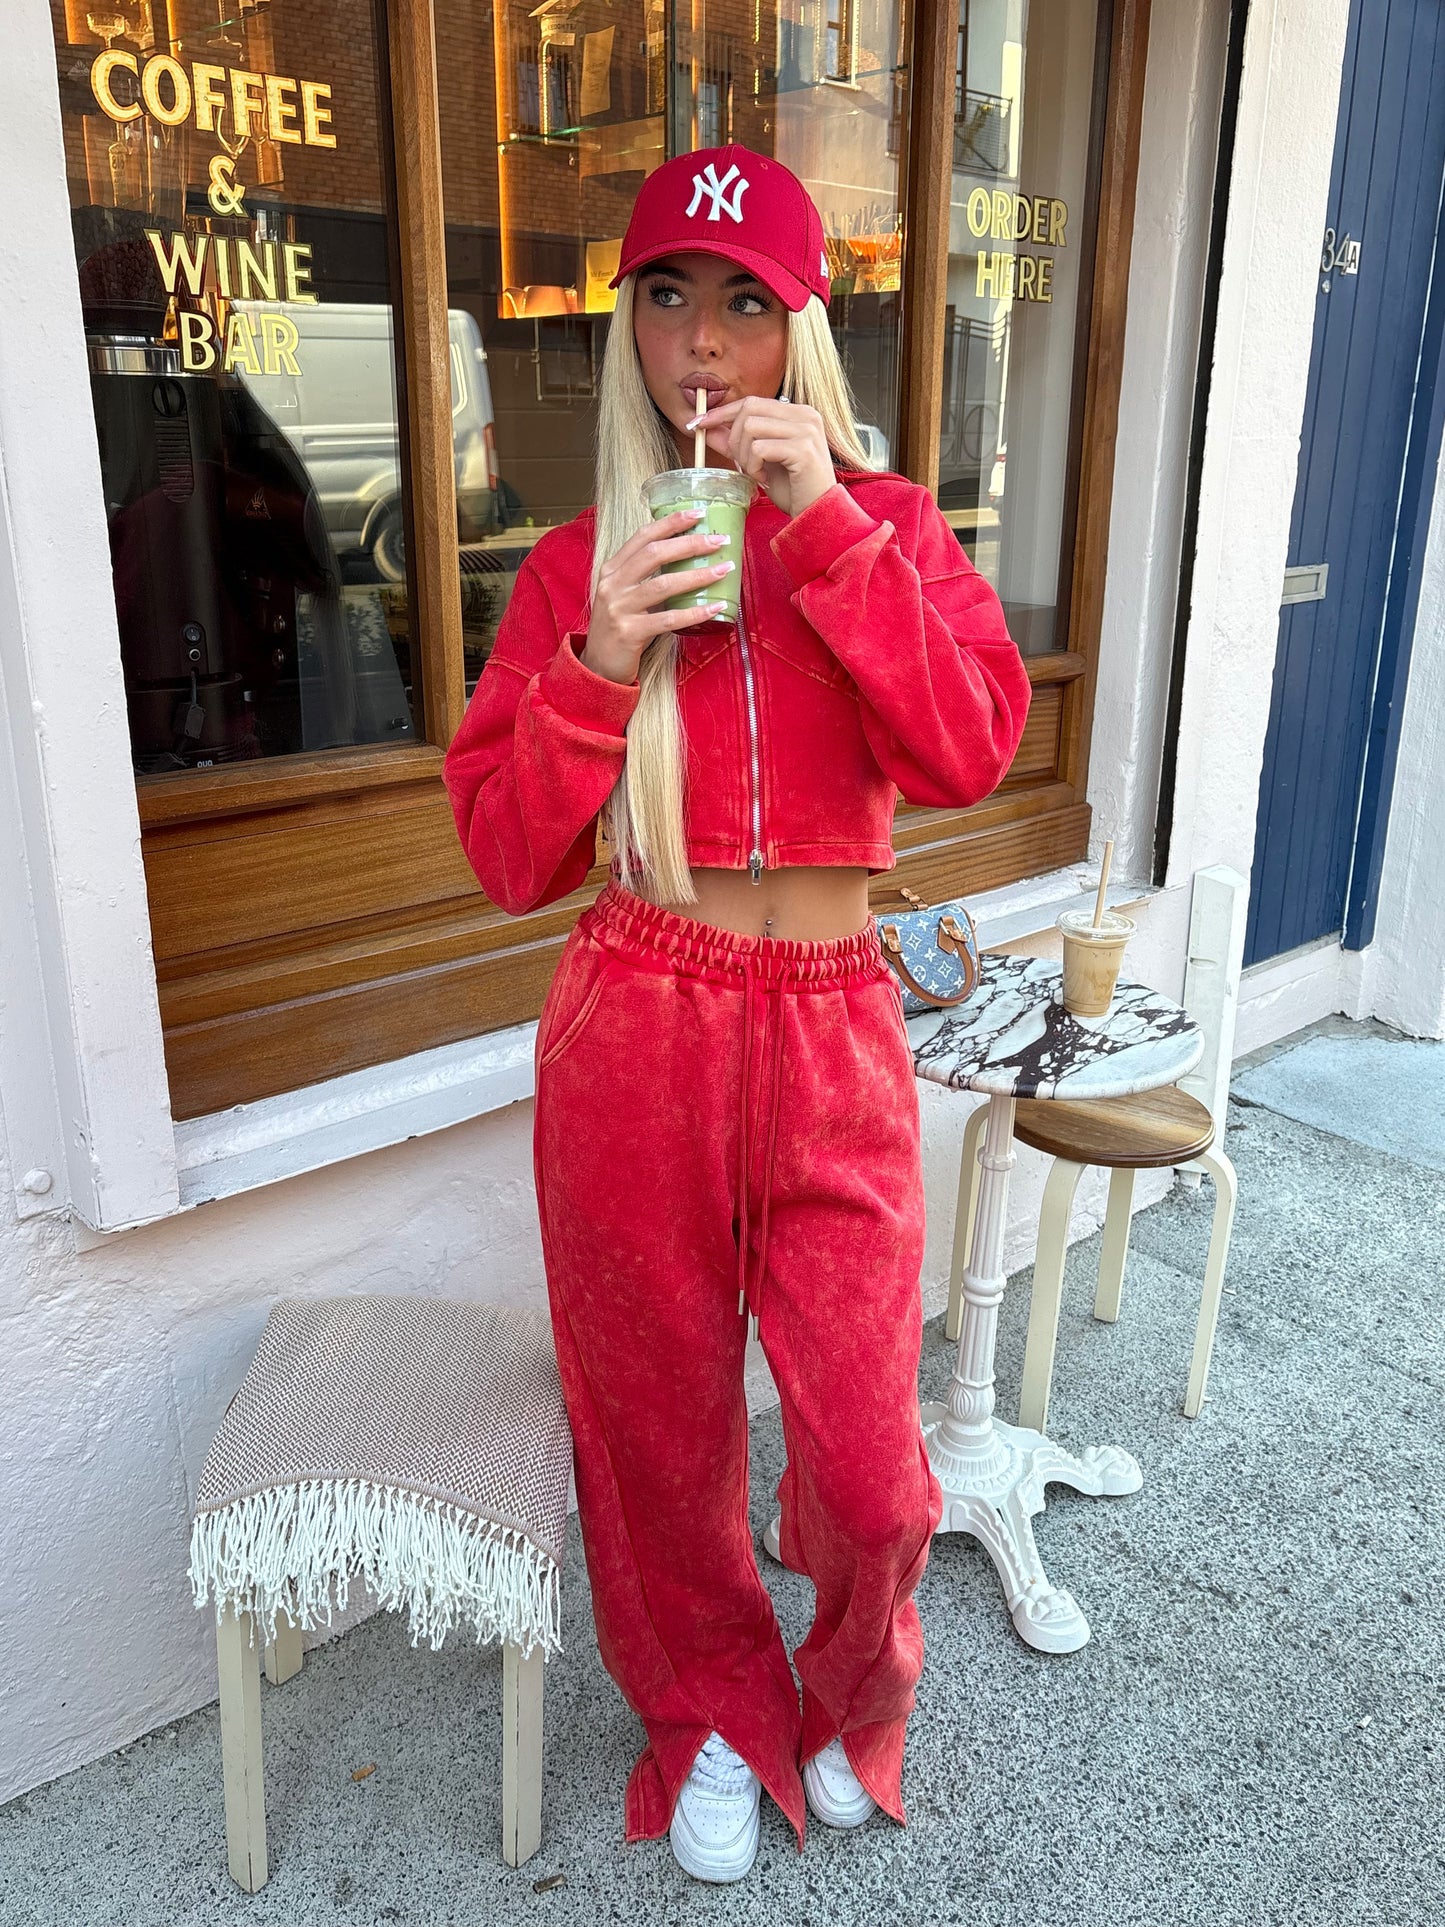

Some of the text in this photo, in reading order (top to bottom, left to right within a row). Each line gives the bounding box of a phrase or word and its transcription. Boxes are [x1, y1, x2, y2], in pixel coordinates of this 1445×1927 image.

[90, 49, 337, 148] COFFEE
[208, 155, 248, 217] &
[685, 163, 750, 224] NY
[966, 187, 1068, 247] ORDER
[144, 228, 319, 305] WINE
[975, 250, 1054, 303] HERE
[178, 307, 303, 376] BAR
